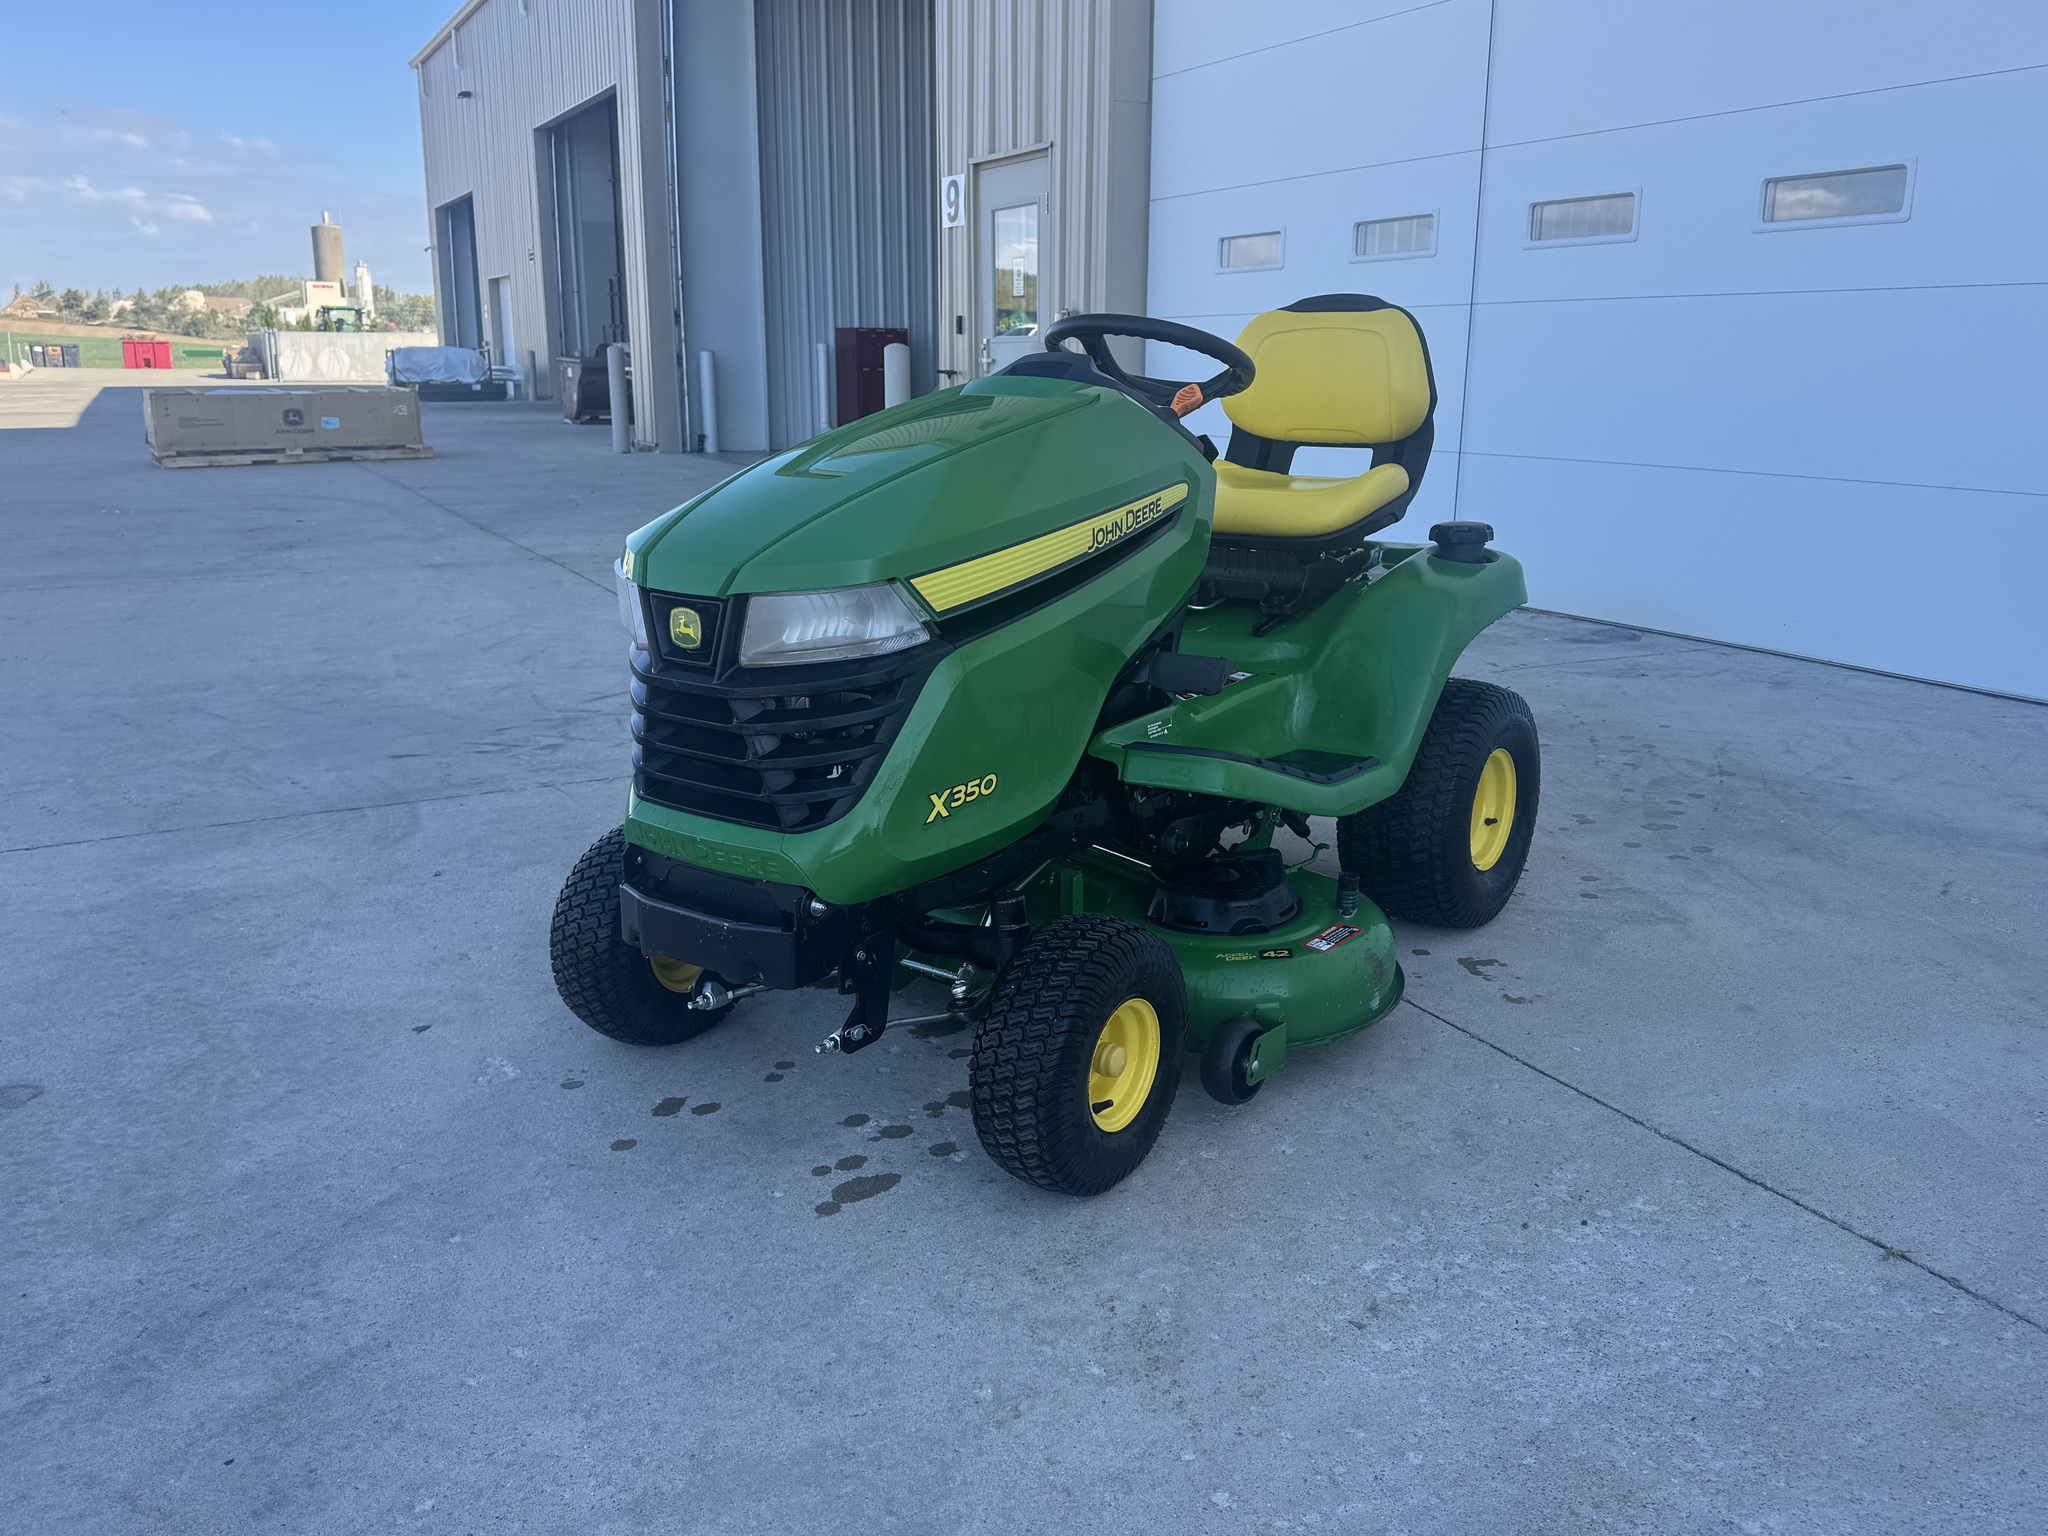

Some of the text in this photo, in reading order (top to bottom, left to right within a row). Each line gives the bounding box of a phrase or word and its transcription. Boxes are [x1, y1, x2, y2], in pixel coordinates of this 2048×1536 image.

[946, 179, 960, 224] 9
[1087, 497, 1162, 551] JOHN DEERE
[924, 773, 997, 825] X350
[637, 822, 782, 878] JOHN DEERE
[1262, 949, 1290, 958] 42
